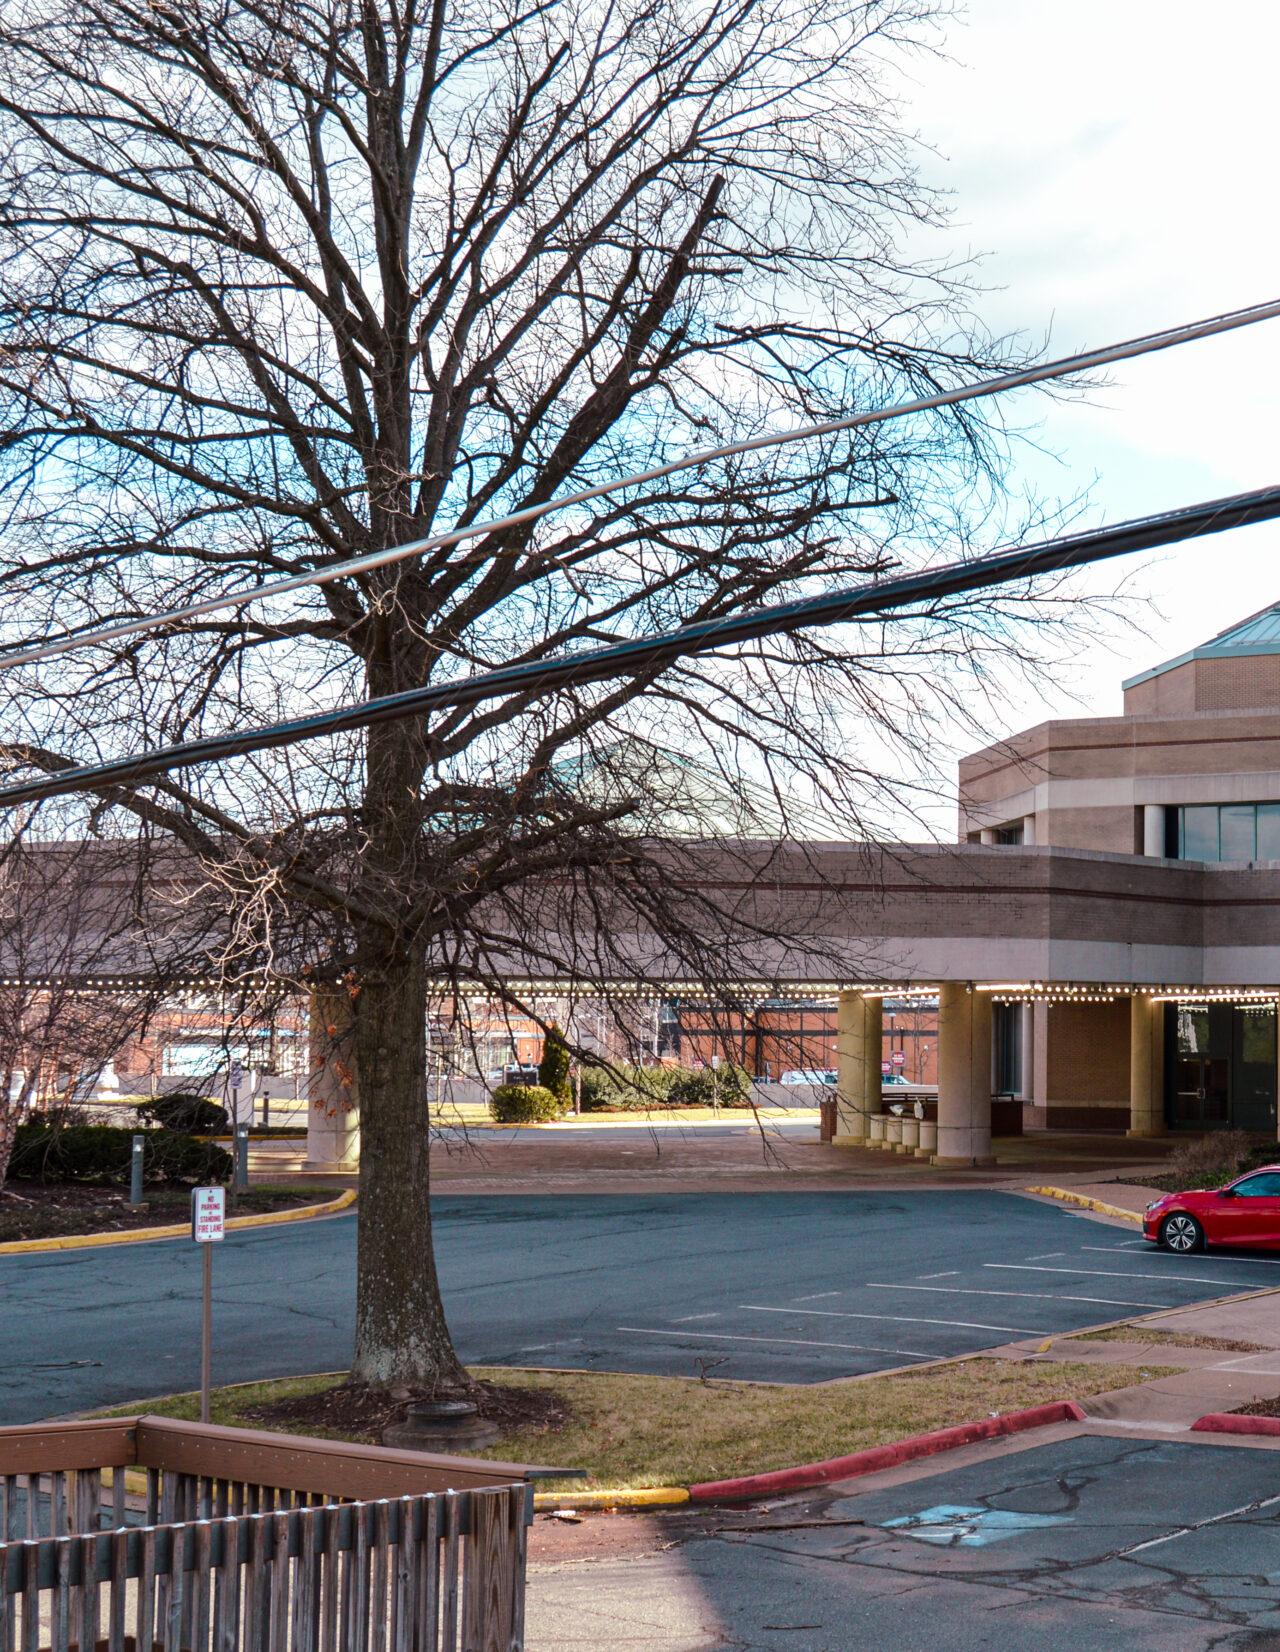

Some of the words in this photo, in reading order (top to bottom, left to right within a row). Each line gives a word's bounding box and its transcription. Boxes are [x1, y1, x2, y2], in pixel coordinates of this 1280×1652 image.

[200, 1215, 221, 1223] STANDING
[198, 1225, 208, 1233] FIRE
[210, 1224, 222, 1232] LANE
